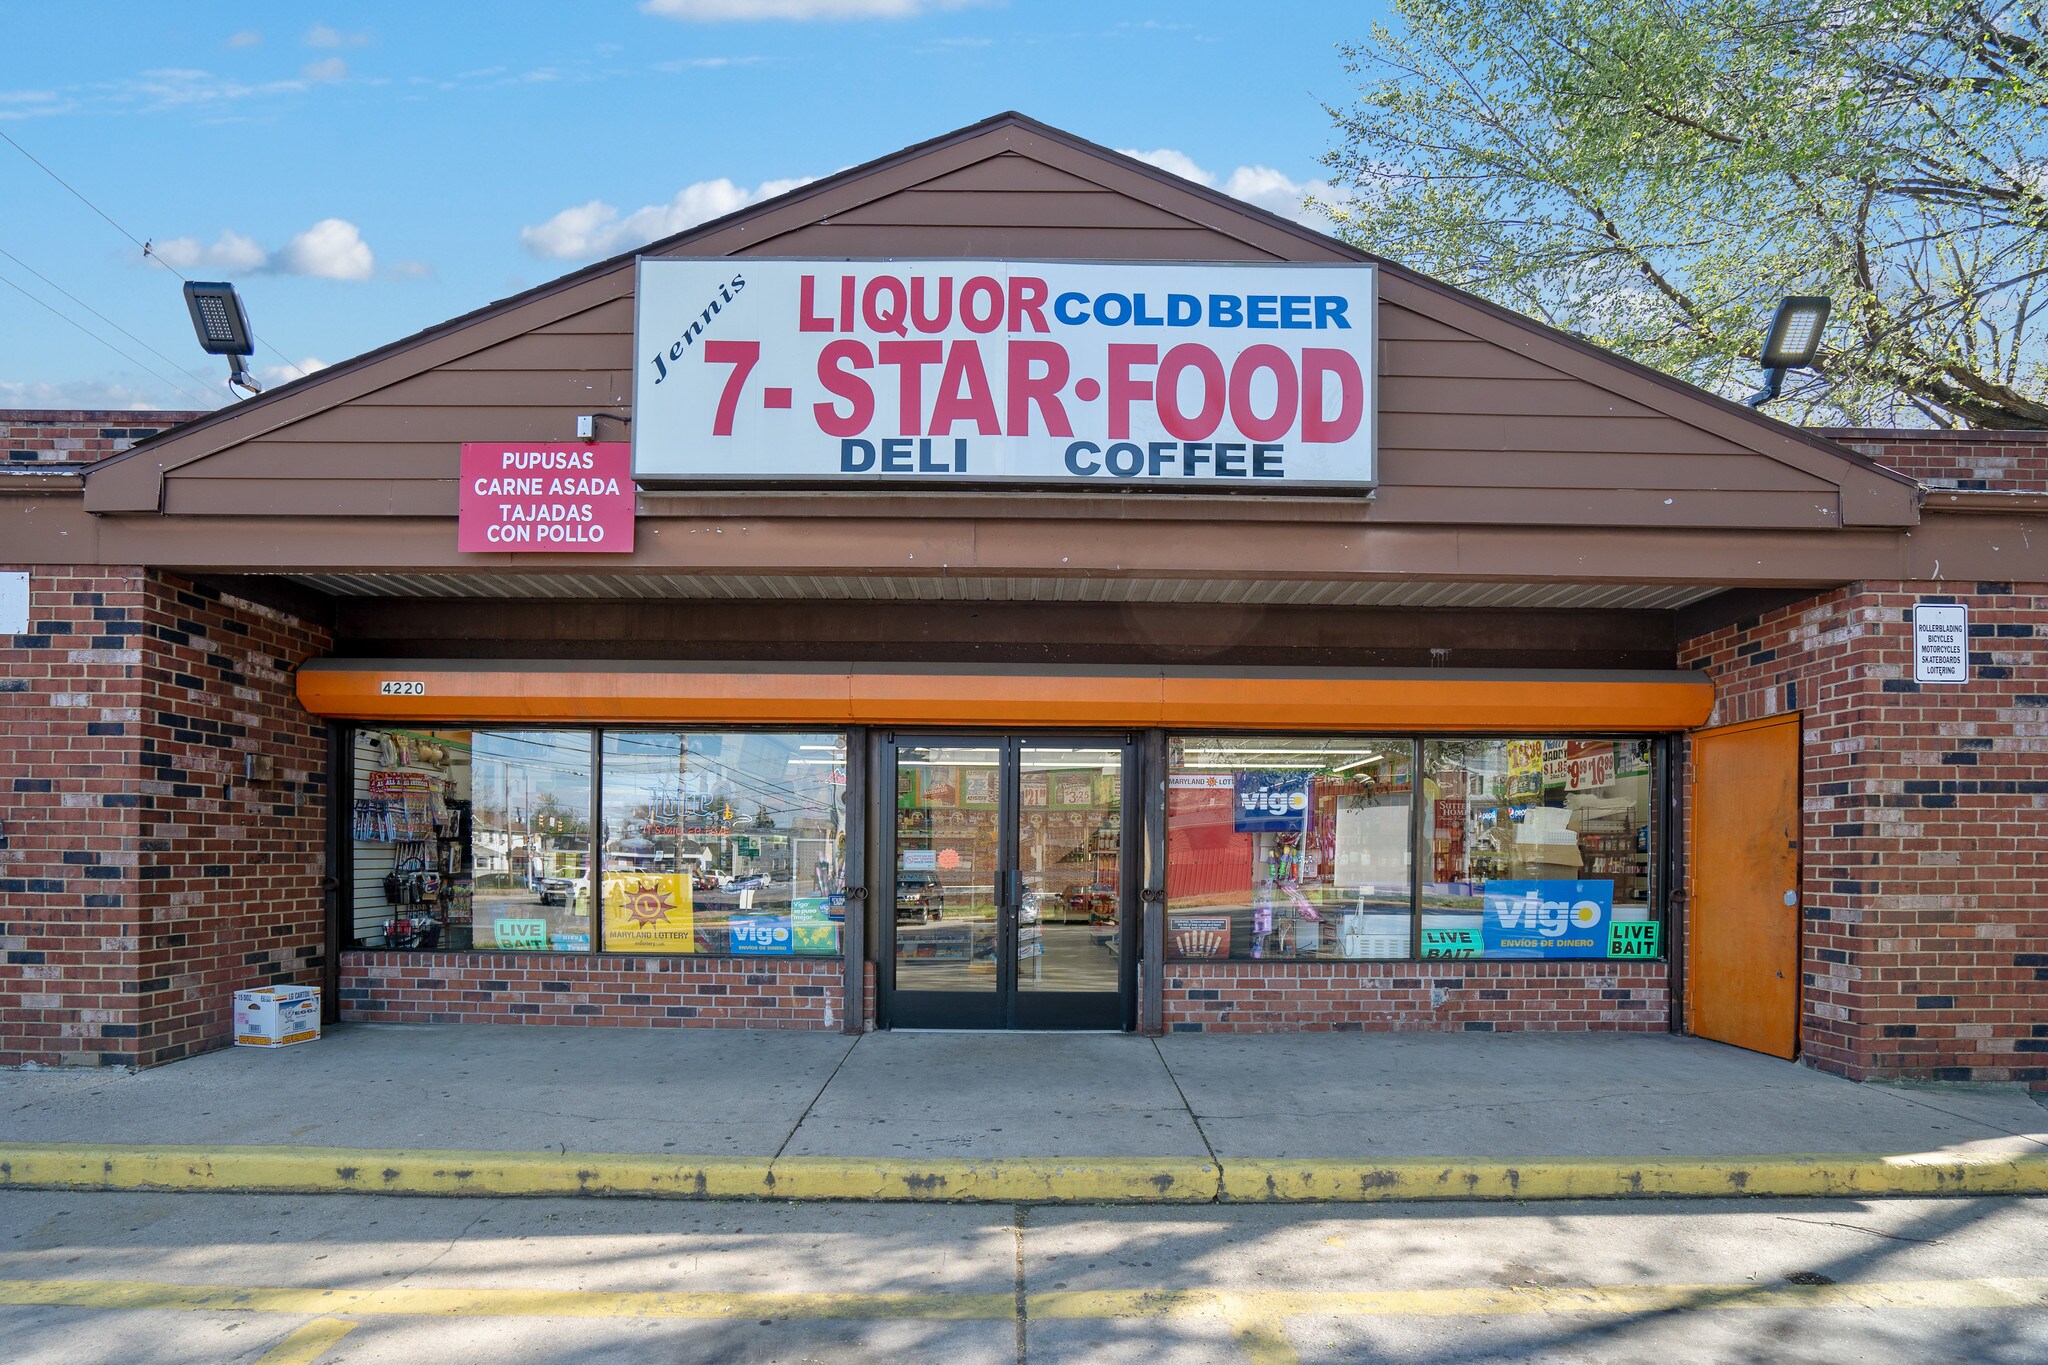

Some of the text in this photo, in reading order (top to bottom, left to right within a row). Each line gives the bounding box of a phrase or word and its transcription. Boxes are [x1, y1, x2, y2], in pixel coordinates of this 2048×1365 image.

[799, 275, 1051, 338] LIQUOR
[1053, 292, 1352, 329] COLD BEER
[651, 274, 746, 385] Jennis
[502, 452, 594, 469] PUPUSAS
[841, 438, 1285, 477] DELI COFFEE
[474, 478, 620, 496] CARNE ASADA
[499, 504, 593, 522] TAJADAS
[487, 525, 604, 542] CON POLLO
[1918, 624, 1963, 633] ROLLERBLADING
[1927, 635, 1954, 643] BICYCLES
[1921, 645, 1961, 654] MOTORCYCLES
[1921, 656, 1961, 664] SKATEBOARDS
[1926, 666, 1956, 675] LOITERING
[382, 682, 424, 695] 4220
[1240, 787, 1308, 815] vigo
[1494, 891, 1602, 937] vigo
[499, 924, 541, 937] LIVE
[609, 931, 652, 939] MARYLAND
[733, 922, 789, 945] vigo
[1427, 932, 1472, 943] LIVE
[1613, 925, 1654, 939] LIVE
[1500, 937, 1594, 947] ENVÍOS DE DINERO
[1611, 940, 1655, 955] BAIT
[1425, 948, 1475, 959] BAIT
